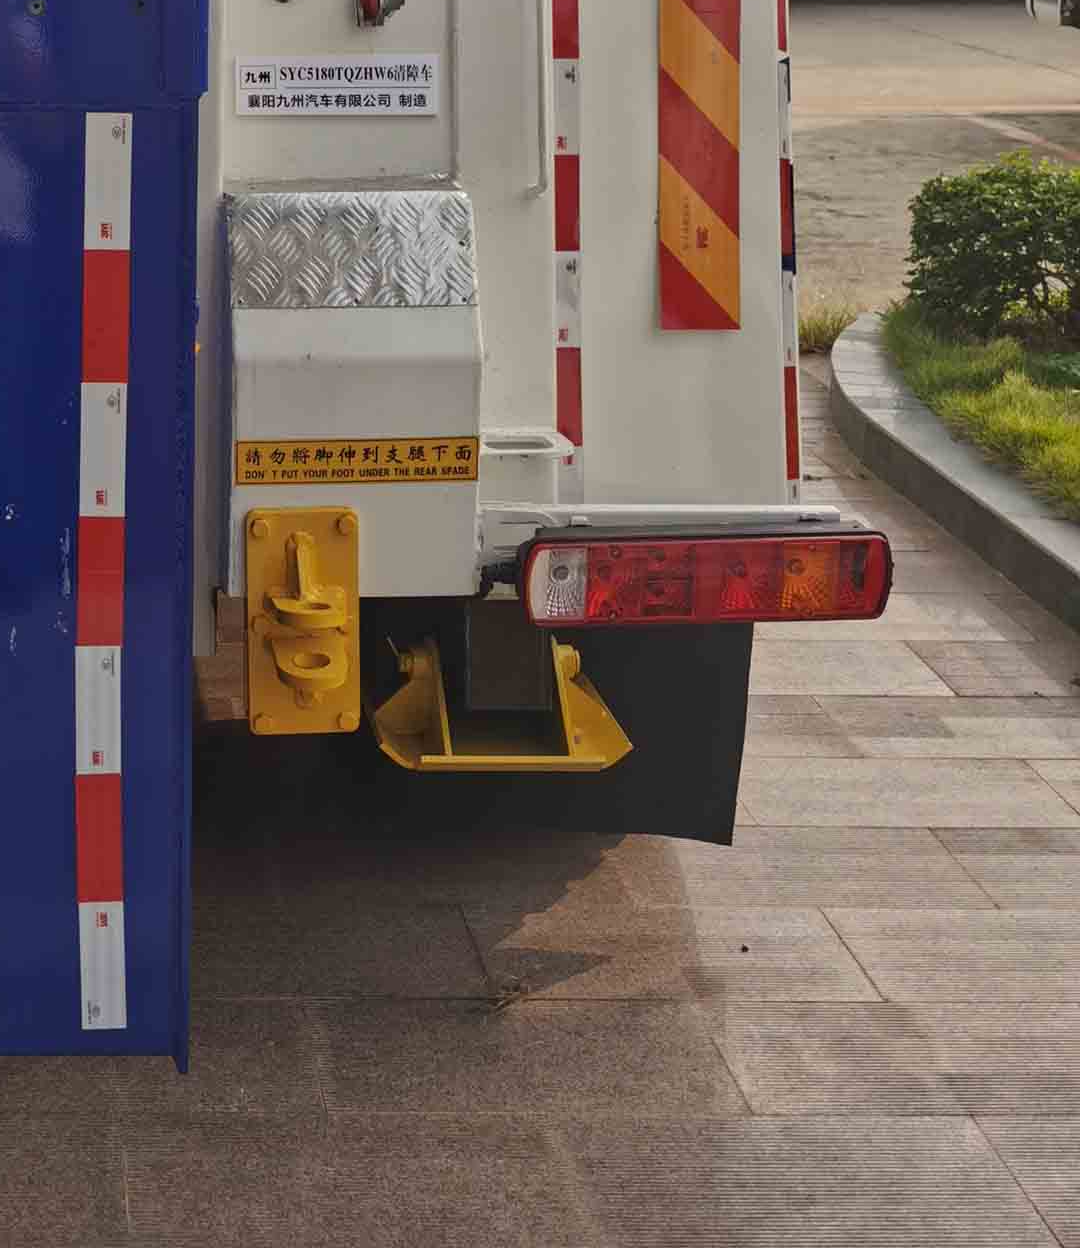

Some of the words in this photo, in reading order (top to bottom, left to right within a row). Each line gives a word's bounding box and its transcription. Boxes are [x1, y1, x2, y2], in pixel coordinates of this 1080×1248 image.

[245, 71, 271, 83] 九州
[247, 93, 391, 107] 襄阳九州汽车有限公司
[398, 93, 426, 107] 制造
[281, 469, 298, 479] PUT
[303, 469, 328, 479] YOUR
[331, 468, 355, 478] FOOT
[359, 467, 390, 477] UNDER
[394, 467, 410, 477] THE
[414, 466, 438, 476] REAR
[441, 465, 471, 475] SPADE
